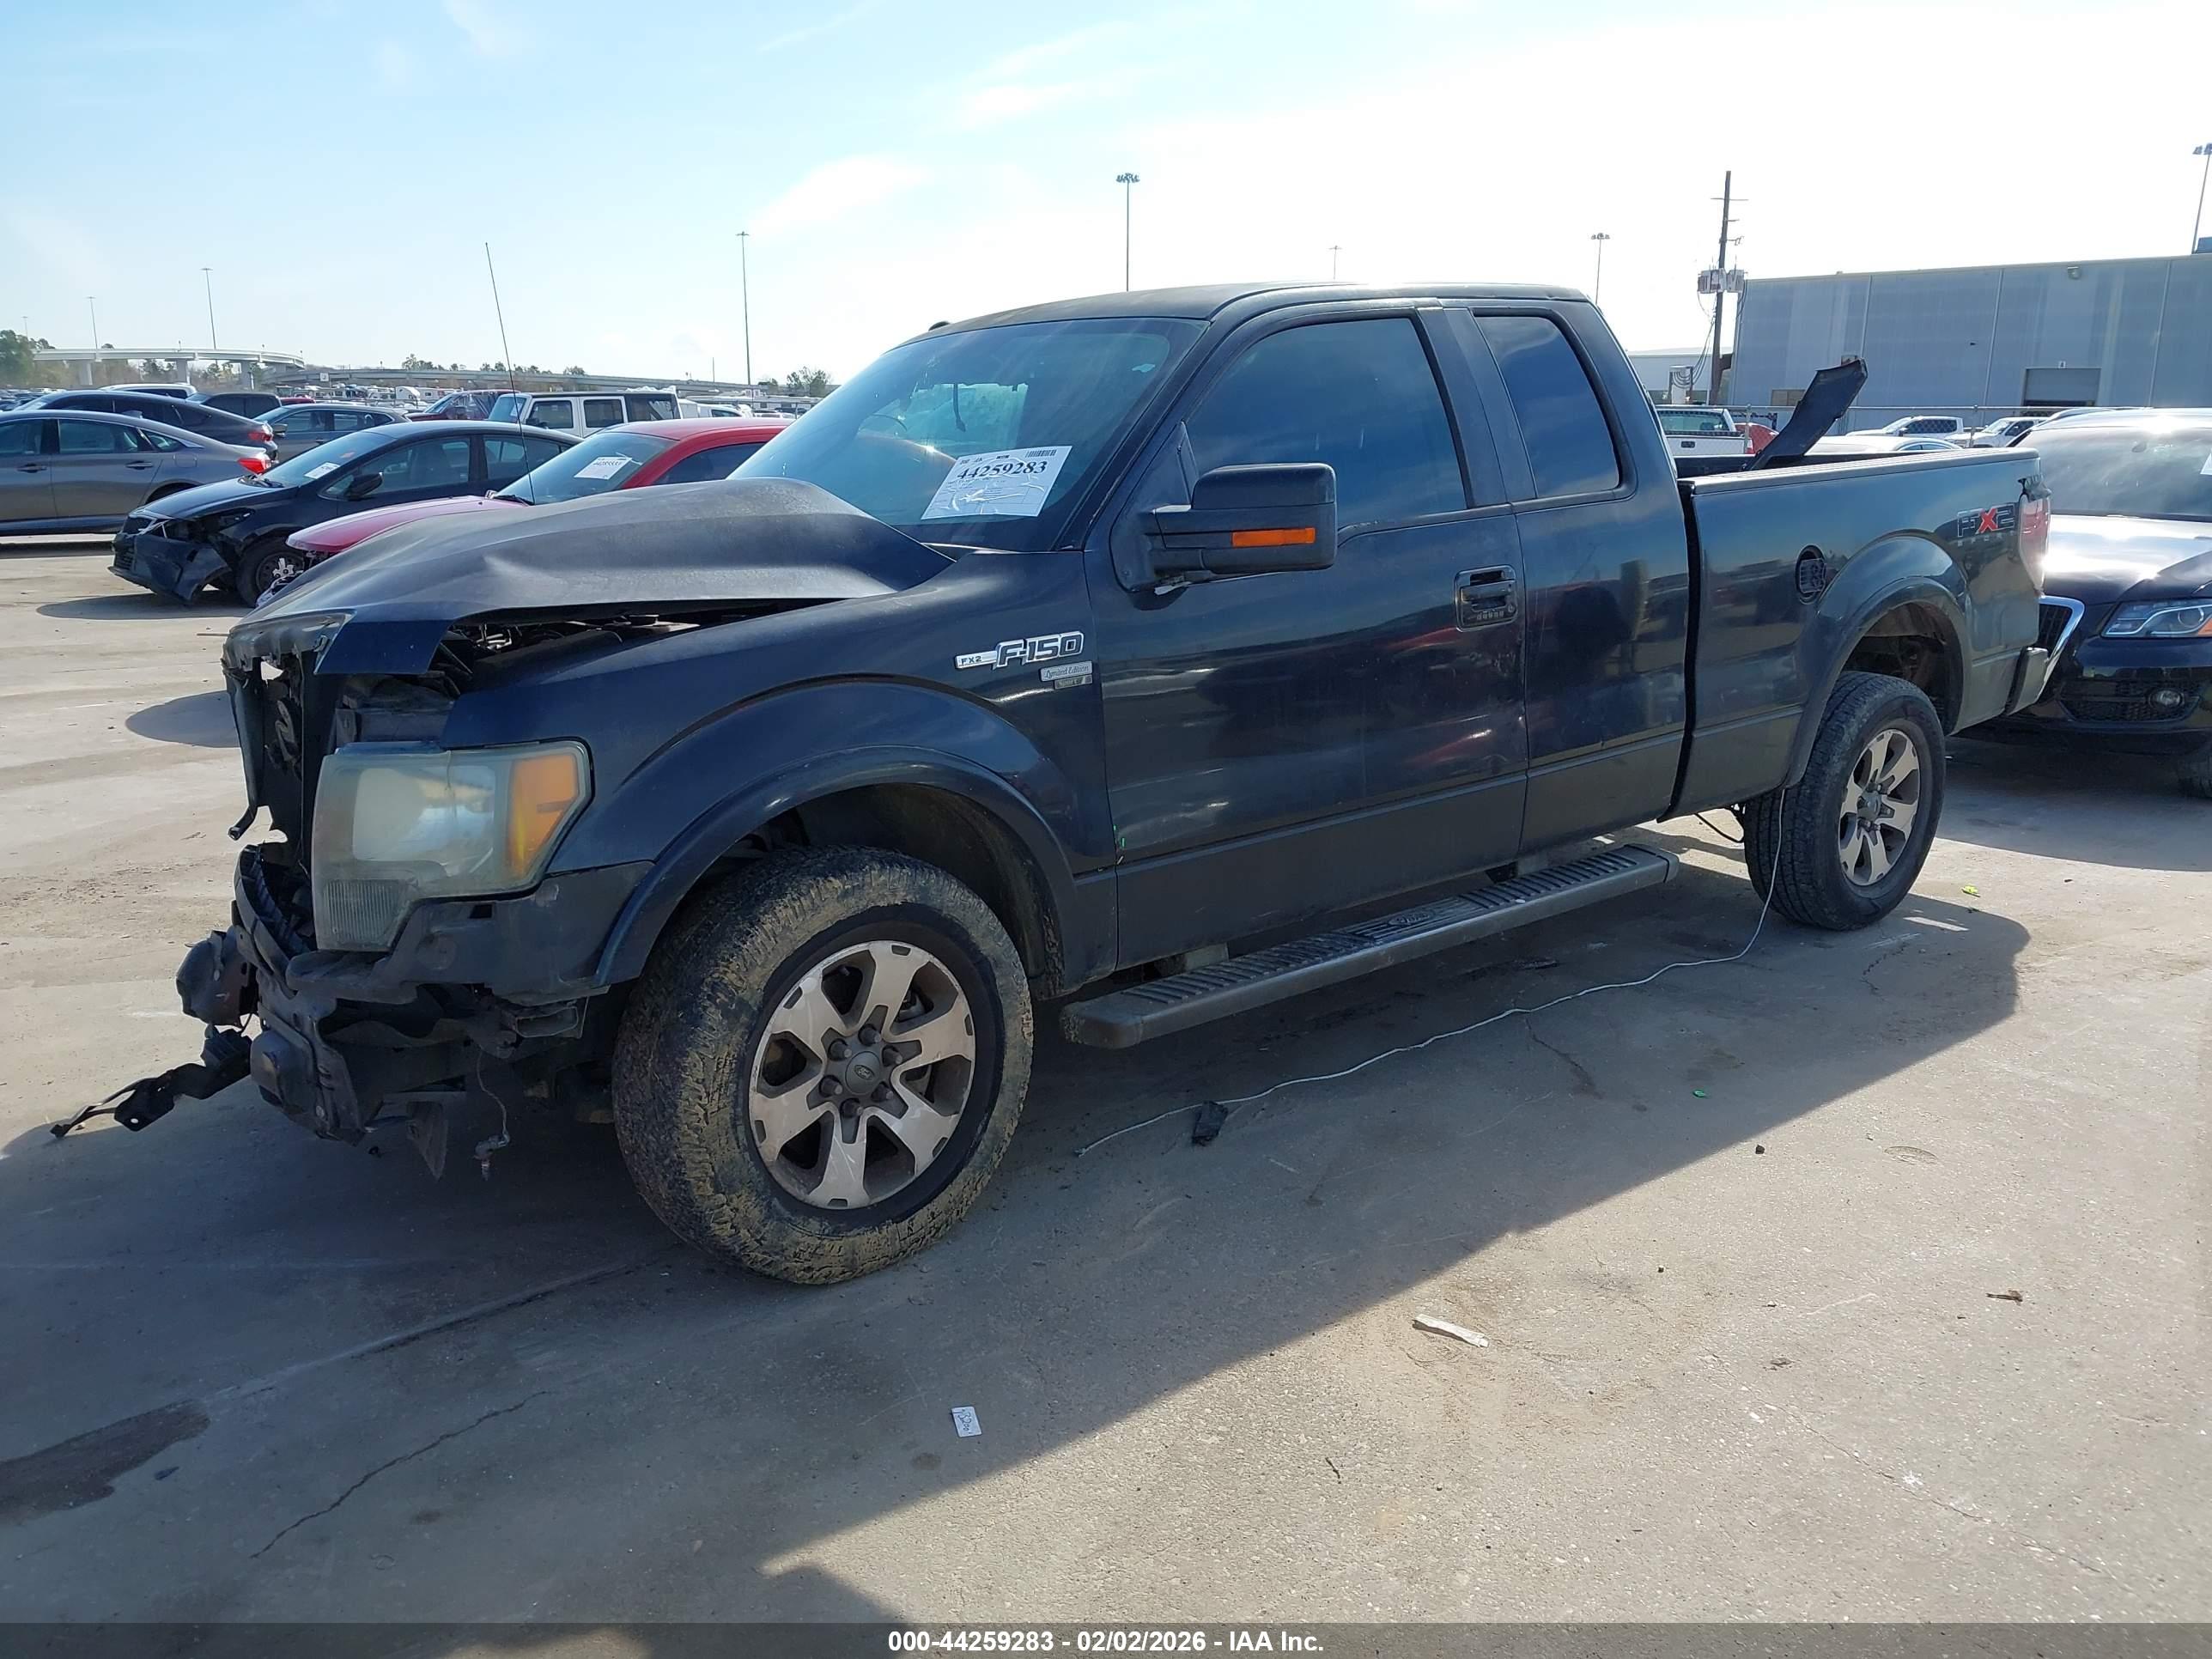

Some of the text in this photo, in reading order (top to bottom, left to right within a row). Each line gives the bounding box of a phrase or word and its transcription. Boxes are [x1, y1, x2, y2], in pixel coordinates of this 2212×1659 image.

[957, 460, 1048, 479] 44259283
[1957, 503, 2015, 538] FX2
[961, 655, 983, 665] FX2
[994, 630, 1085, 668] F-150
